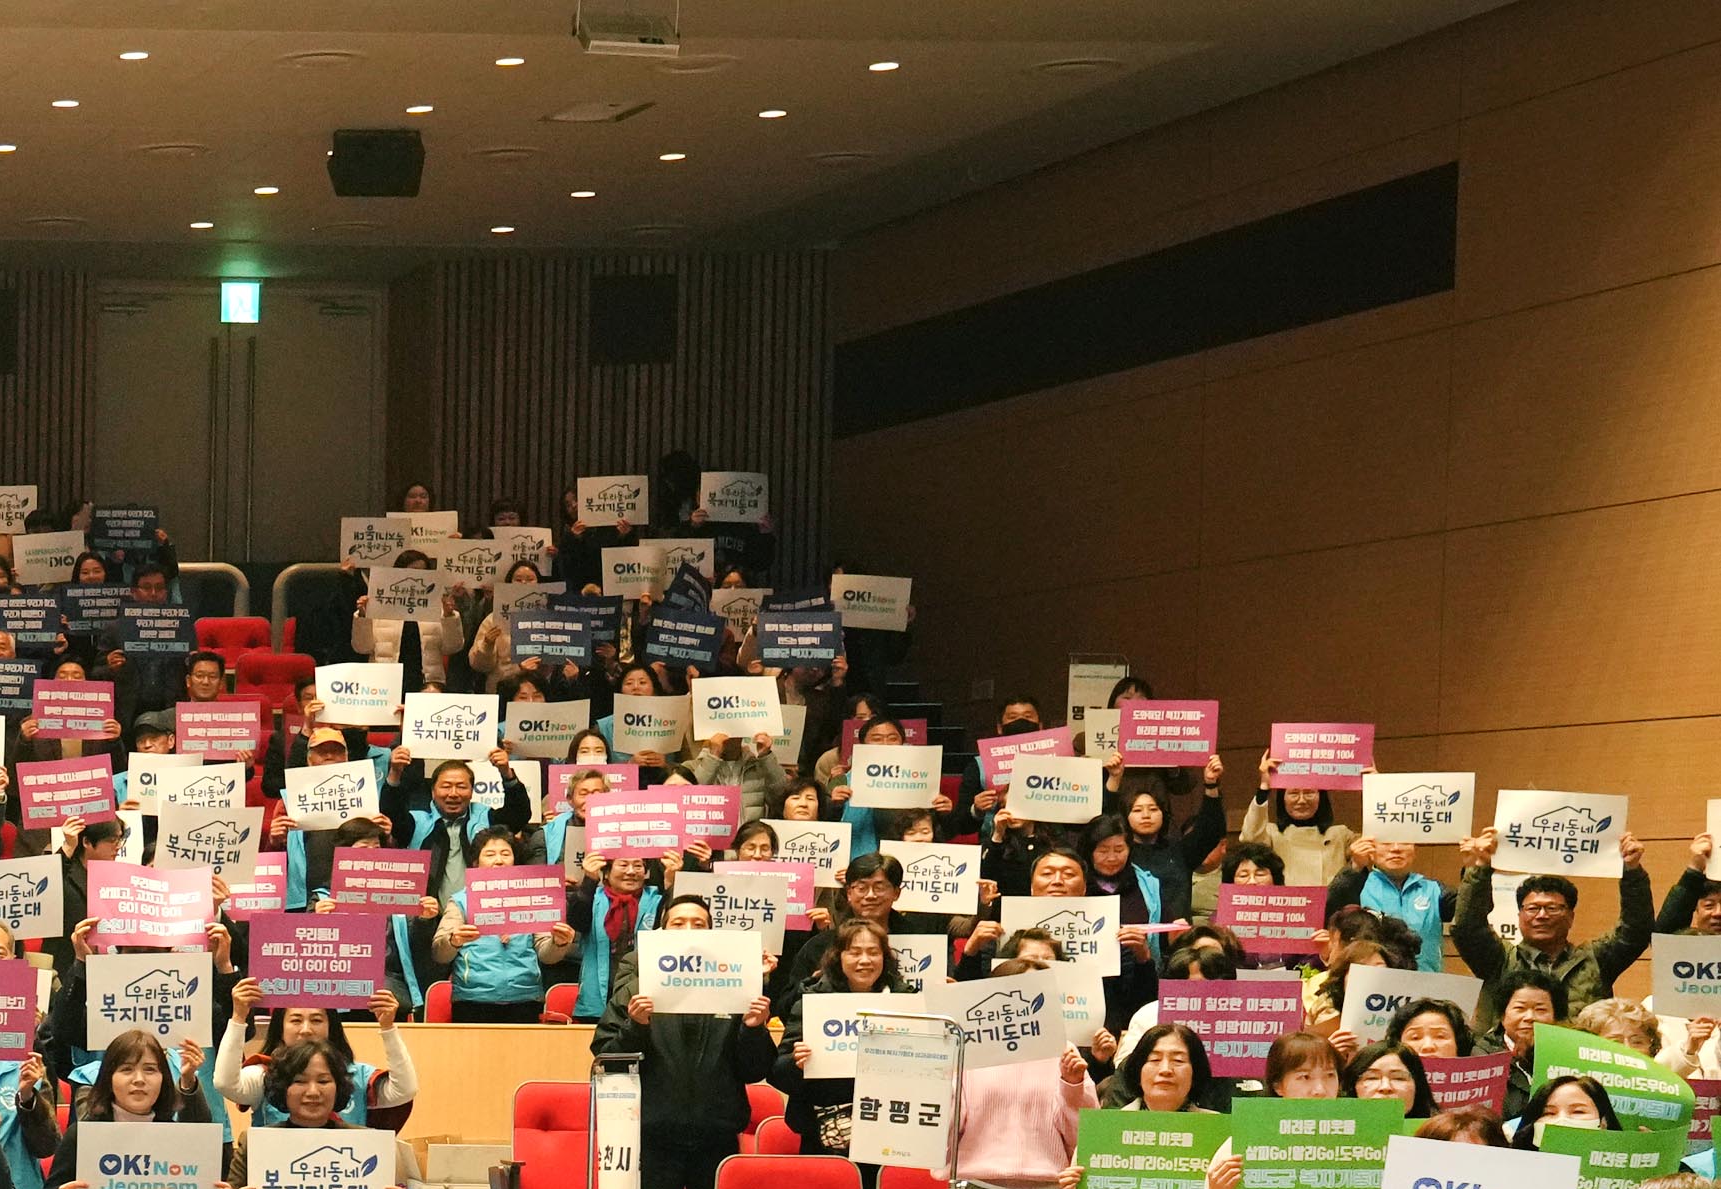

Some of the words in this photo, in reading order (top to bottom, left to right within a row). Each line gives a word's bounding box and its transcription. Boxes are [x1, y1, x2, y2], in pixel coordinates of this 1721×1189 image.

[331, 681, 358, 694] OK!
[331, 694, 388, 706] Jeonnam
[412, 720, 480, 749] 복지기동대
[867, 763, 898, 777] OK!
[867, 777, 928, 790] Jeonnam
[1026, 774, 1059, 790] OK!
[1025, 790, 1088, 804] Jeonnam
[1401, 793, 1447, 810] 우리동네
[1374, 799, 1452, 832] 복지기동대
[1538, 814, 1598, 835] 우리동네
[188, 828, 238, 845] 우리동네
[1505, 821, 1599, 862] 복지기동대
[166, 834, 240, 874] 복지기동대
[282, 959, 303, 973] GO!
[306, 959, 327, 973] GO!
[330, 959, 351, 973] GO!
[659, 954, 703, 973] OK!
[705, 960, 741, 974] Now
[661, 974, 741, 988] Jeonnam
[127, 987, 185, 1002] 우리동네
[100, 994, 192, 1034] 복지기동대
[966, 1001, 1029, 1023] 우리동네
[860, 1096, 941, 1127] 함평군
[98, 1152, 151, 1178] OK!
[153, 1159, 198, 1178] Now
[291, 1158, 360, 1180] 우리동네
